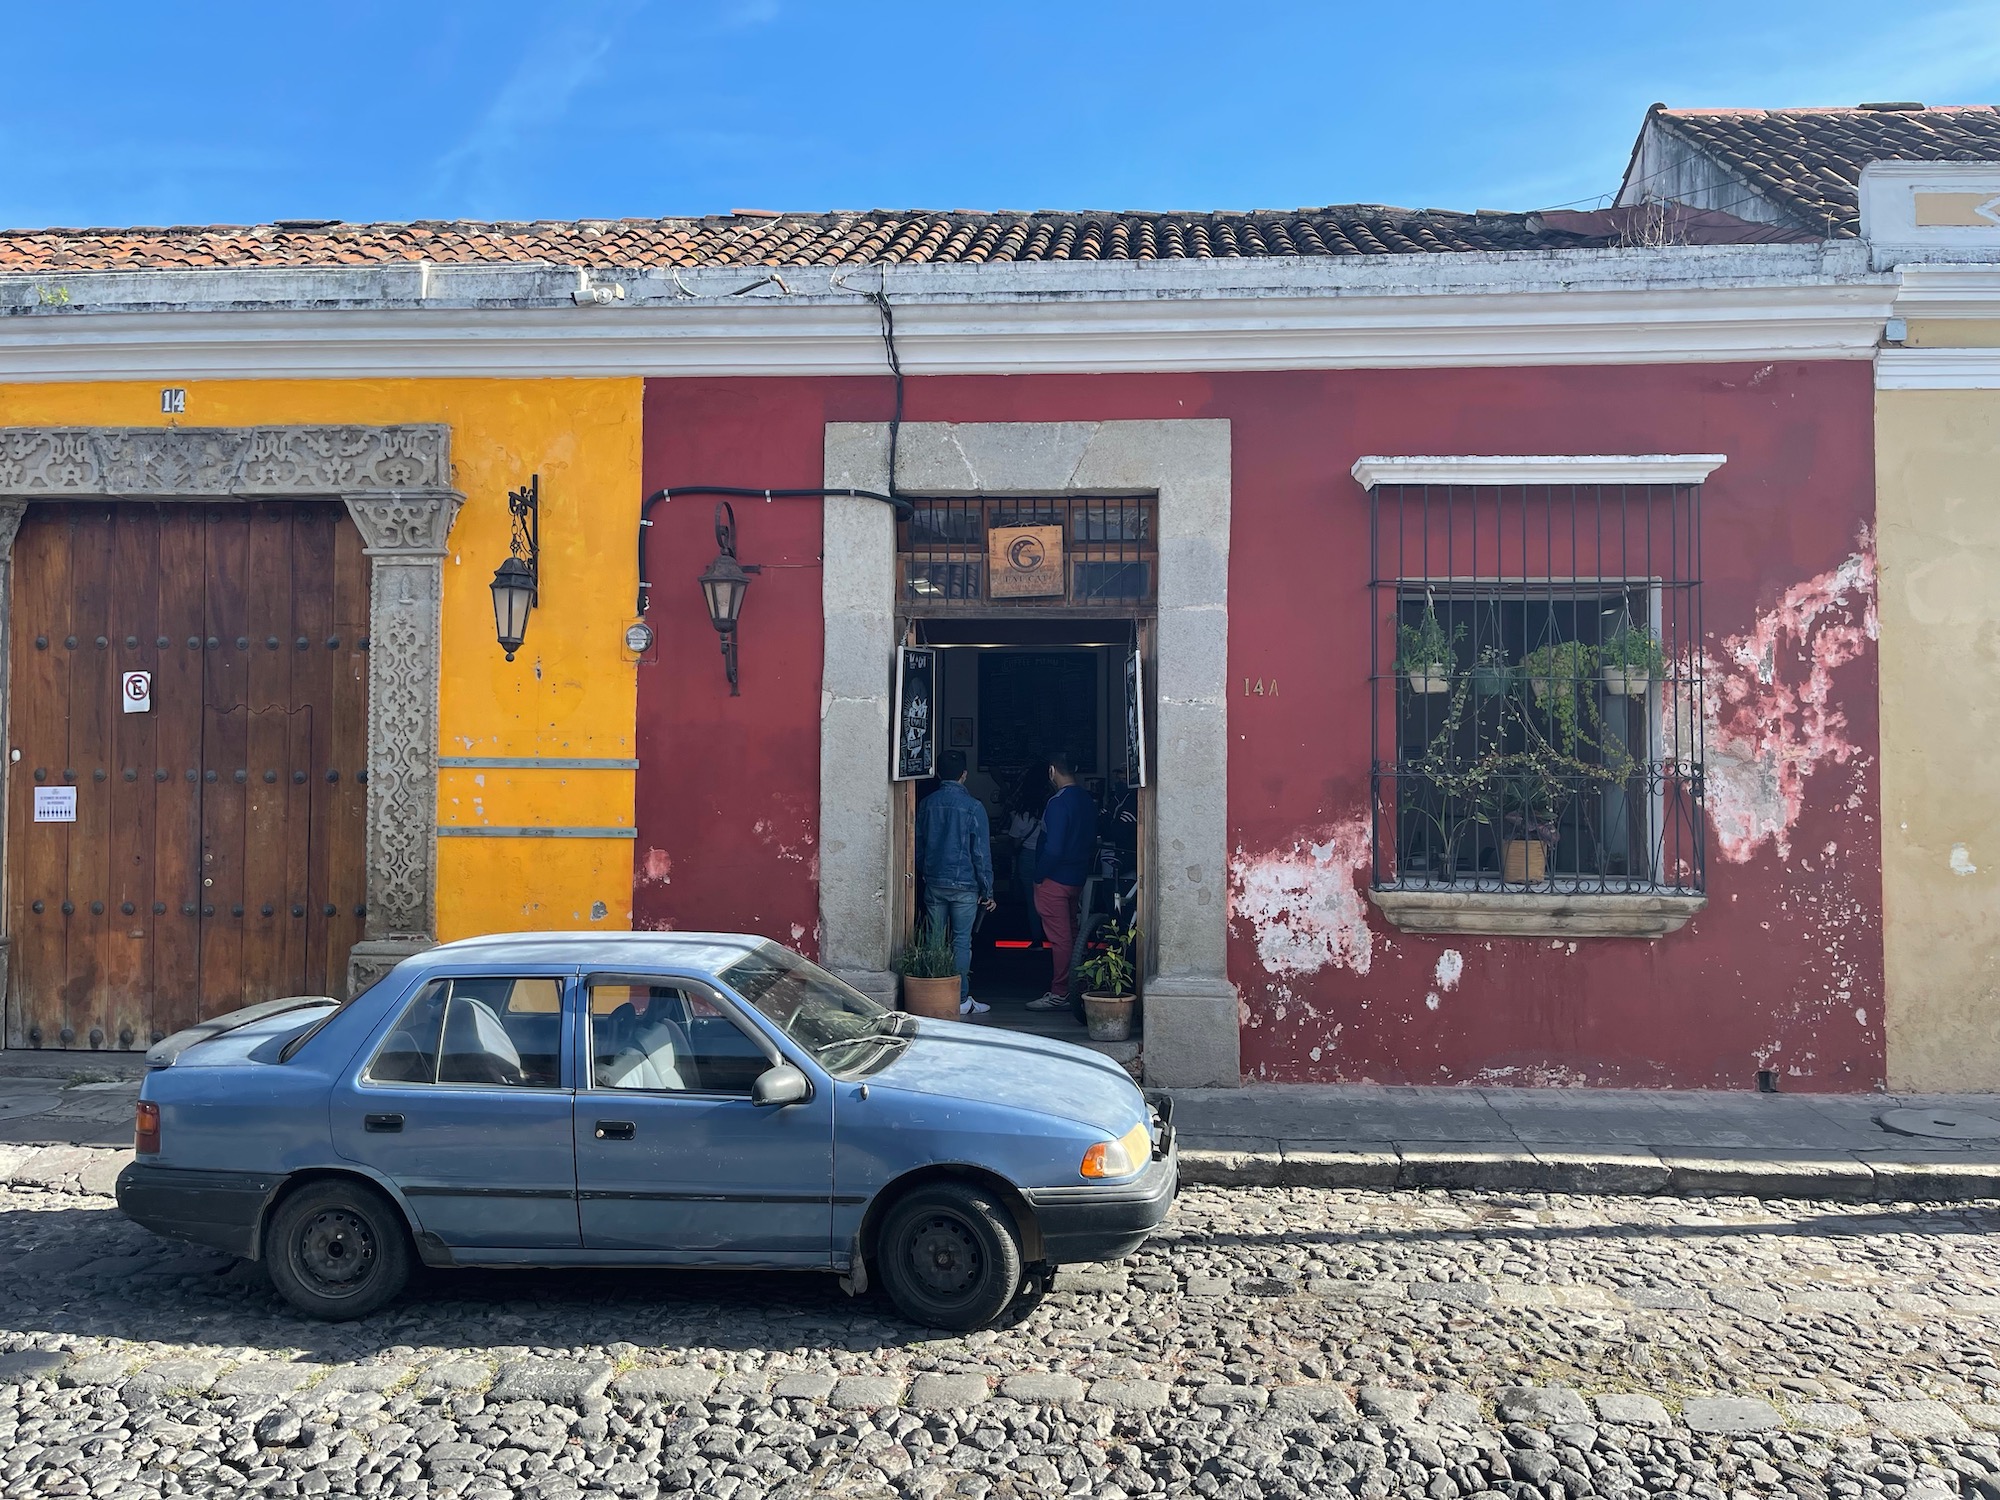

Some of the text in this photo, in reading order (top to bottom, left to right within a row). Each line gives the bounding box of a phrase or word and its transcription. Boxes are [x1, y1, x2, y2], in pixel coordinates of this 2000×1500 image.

[163, 390, 185, 411] 14
[133, 679, 143, 695] E
[1244, 677, 1279, 696] 14A
